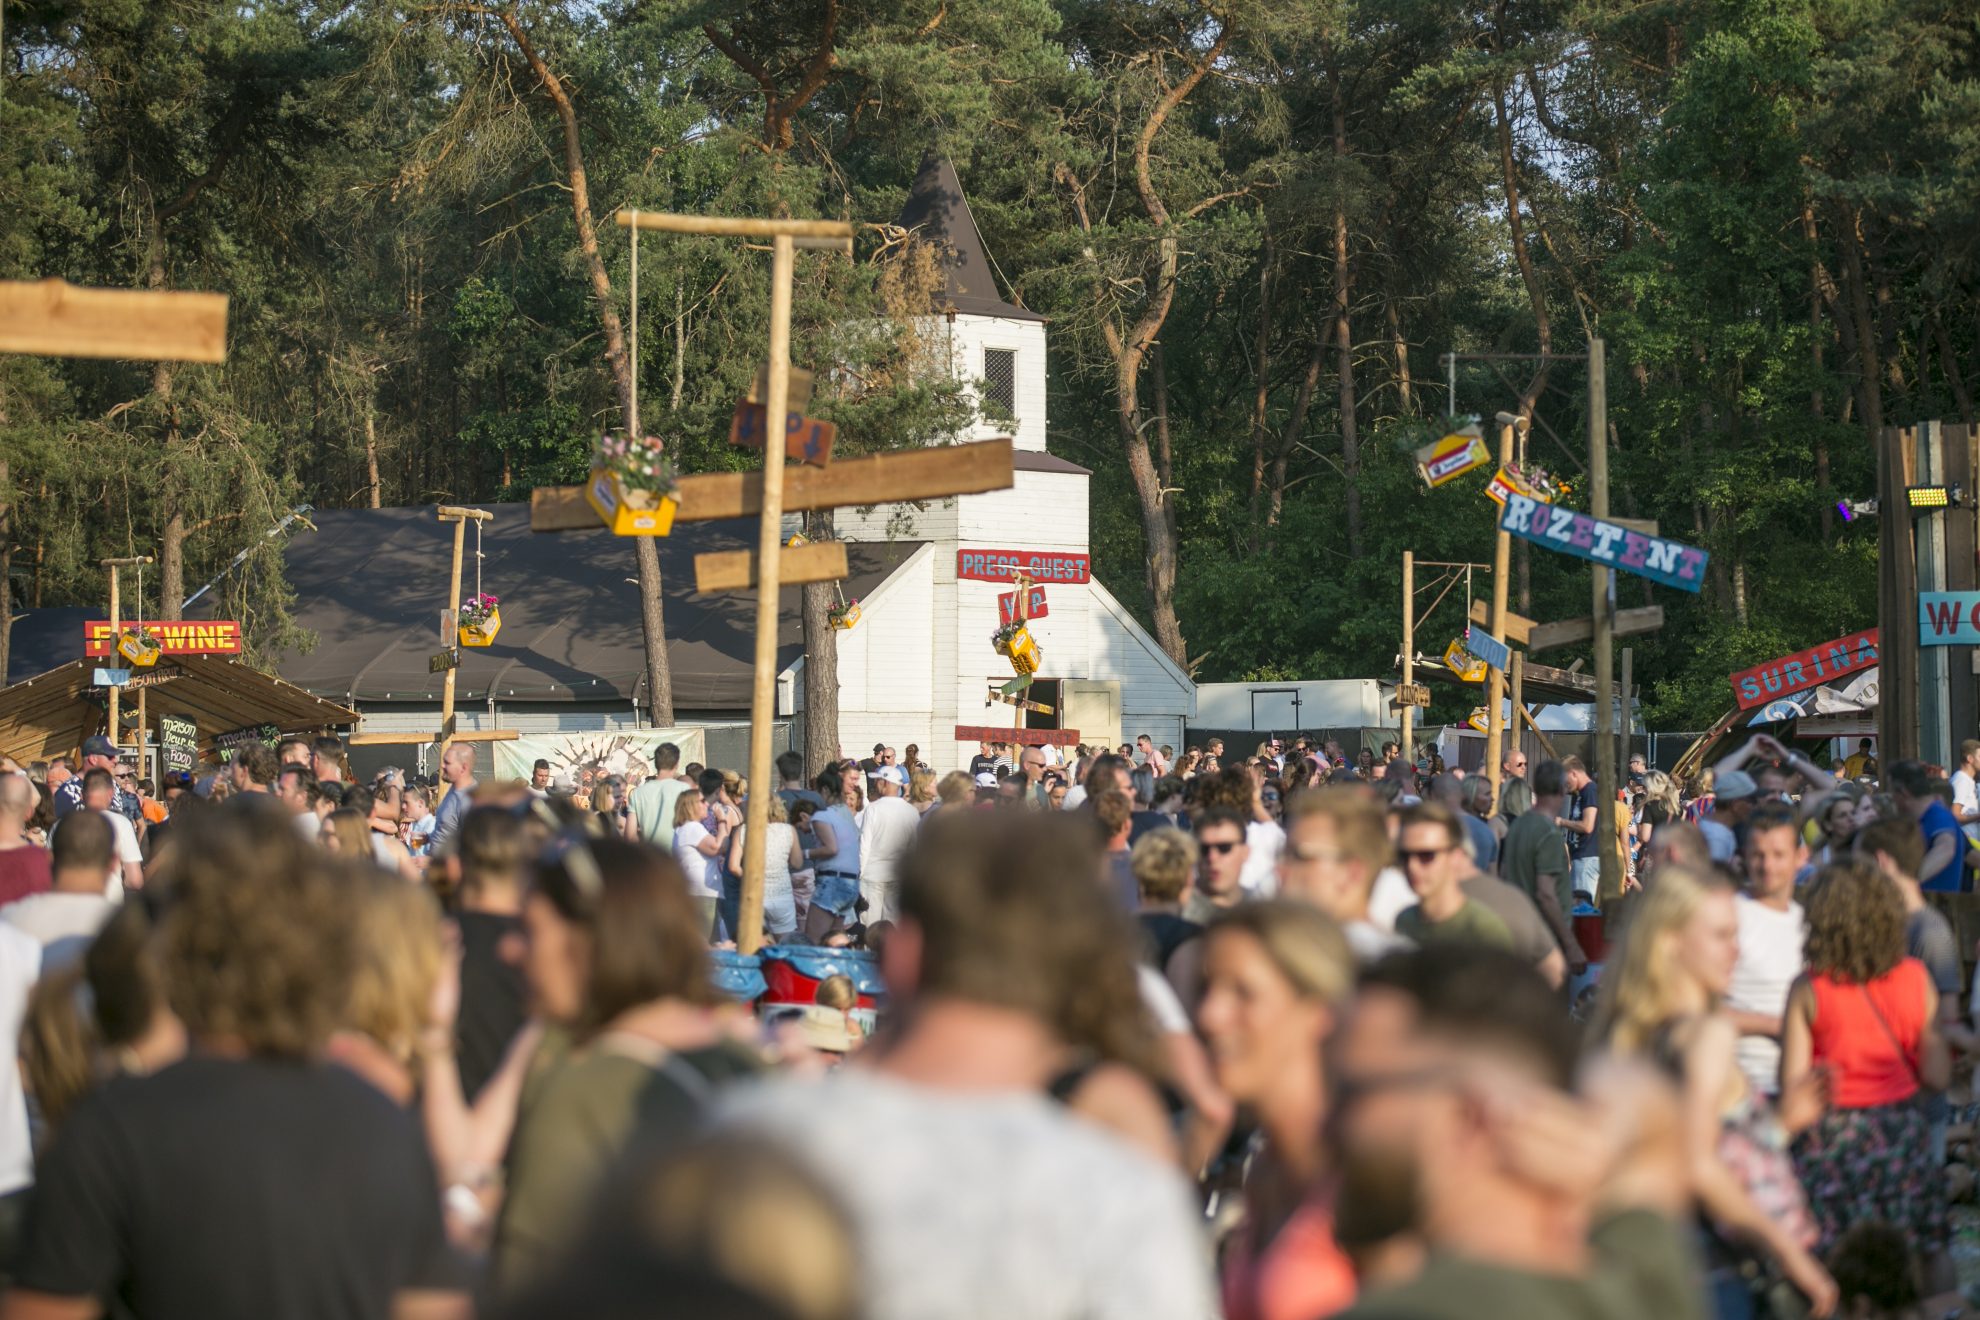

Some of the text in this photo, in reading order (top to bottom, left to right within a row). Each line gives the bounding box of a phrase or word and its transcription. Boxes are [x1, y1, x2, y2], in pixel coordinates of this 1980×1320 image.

[1504, 494, 1704, 580] ROZETENT
[963, 554, 1086, 579] PRESS GUEST
[1004, 592, 1042, 618] VP
